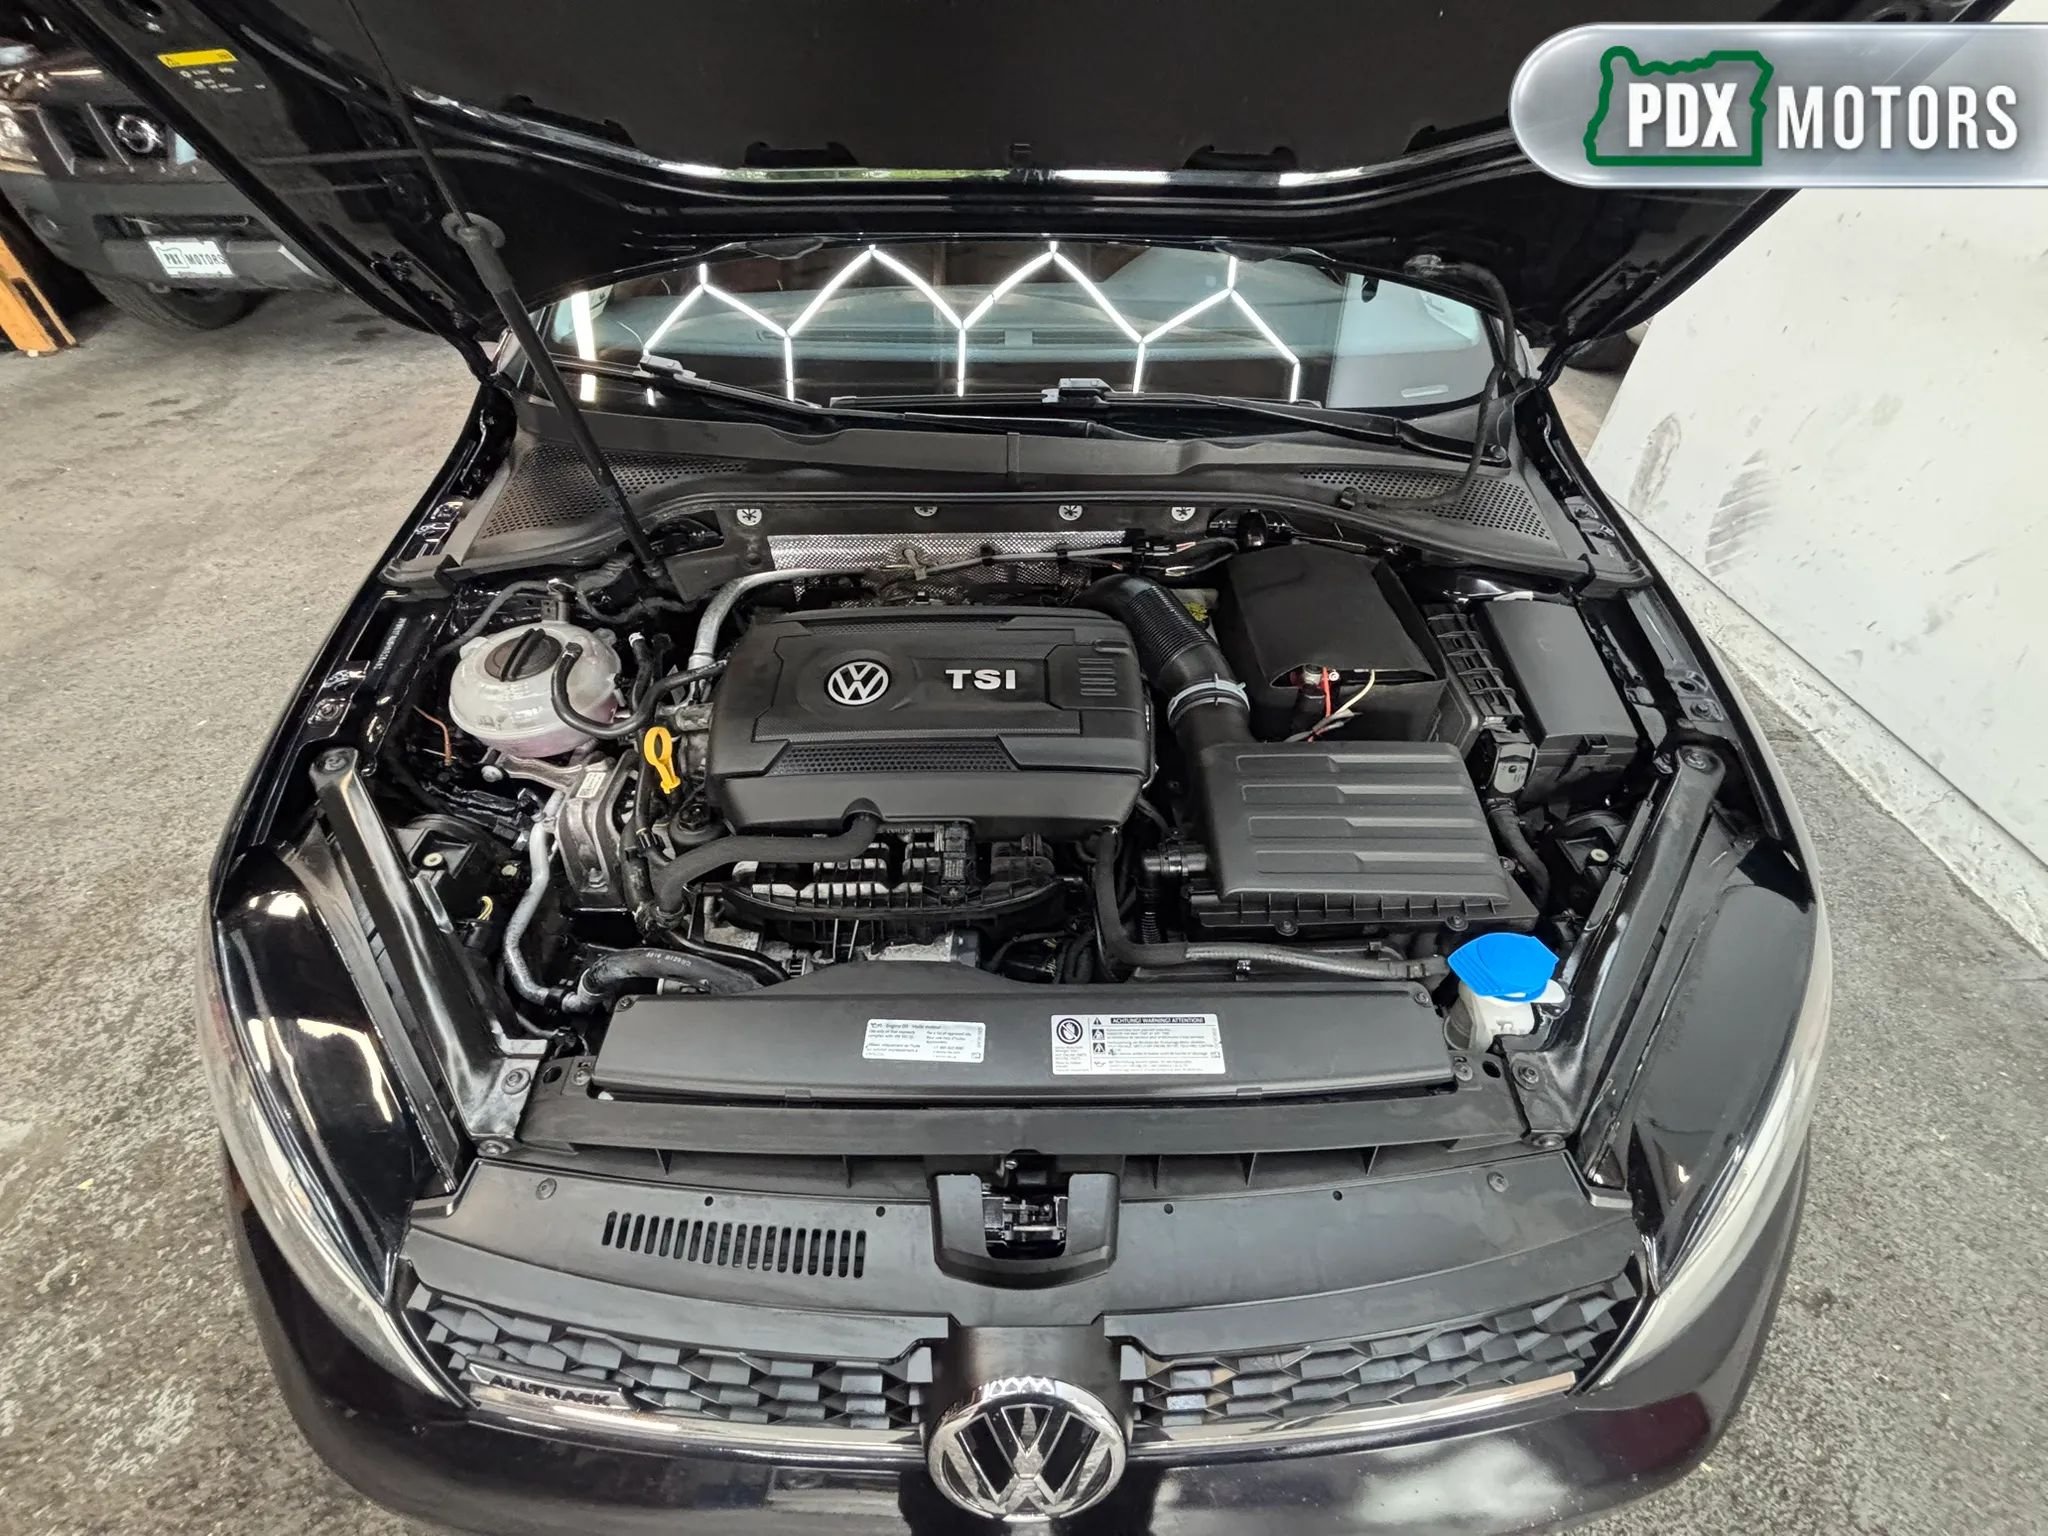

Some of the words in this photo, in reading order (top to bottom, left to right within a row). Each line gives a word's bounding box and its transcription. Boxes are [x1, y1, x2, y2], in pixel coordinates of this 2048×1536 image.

[184, 253, 226, 265] MOTORS
[828, 661, 889, 706] VW
[945, 669, 1016, 690] TSI
[489, 1375, 611, 1406] ALLTRACK
[934, 1382, 1120, 1519] VW
